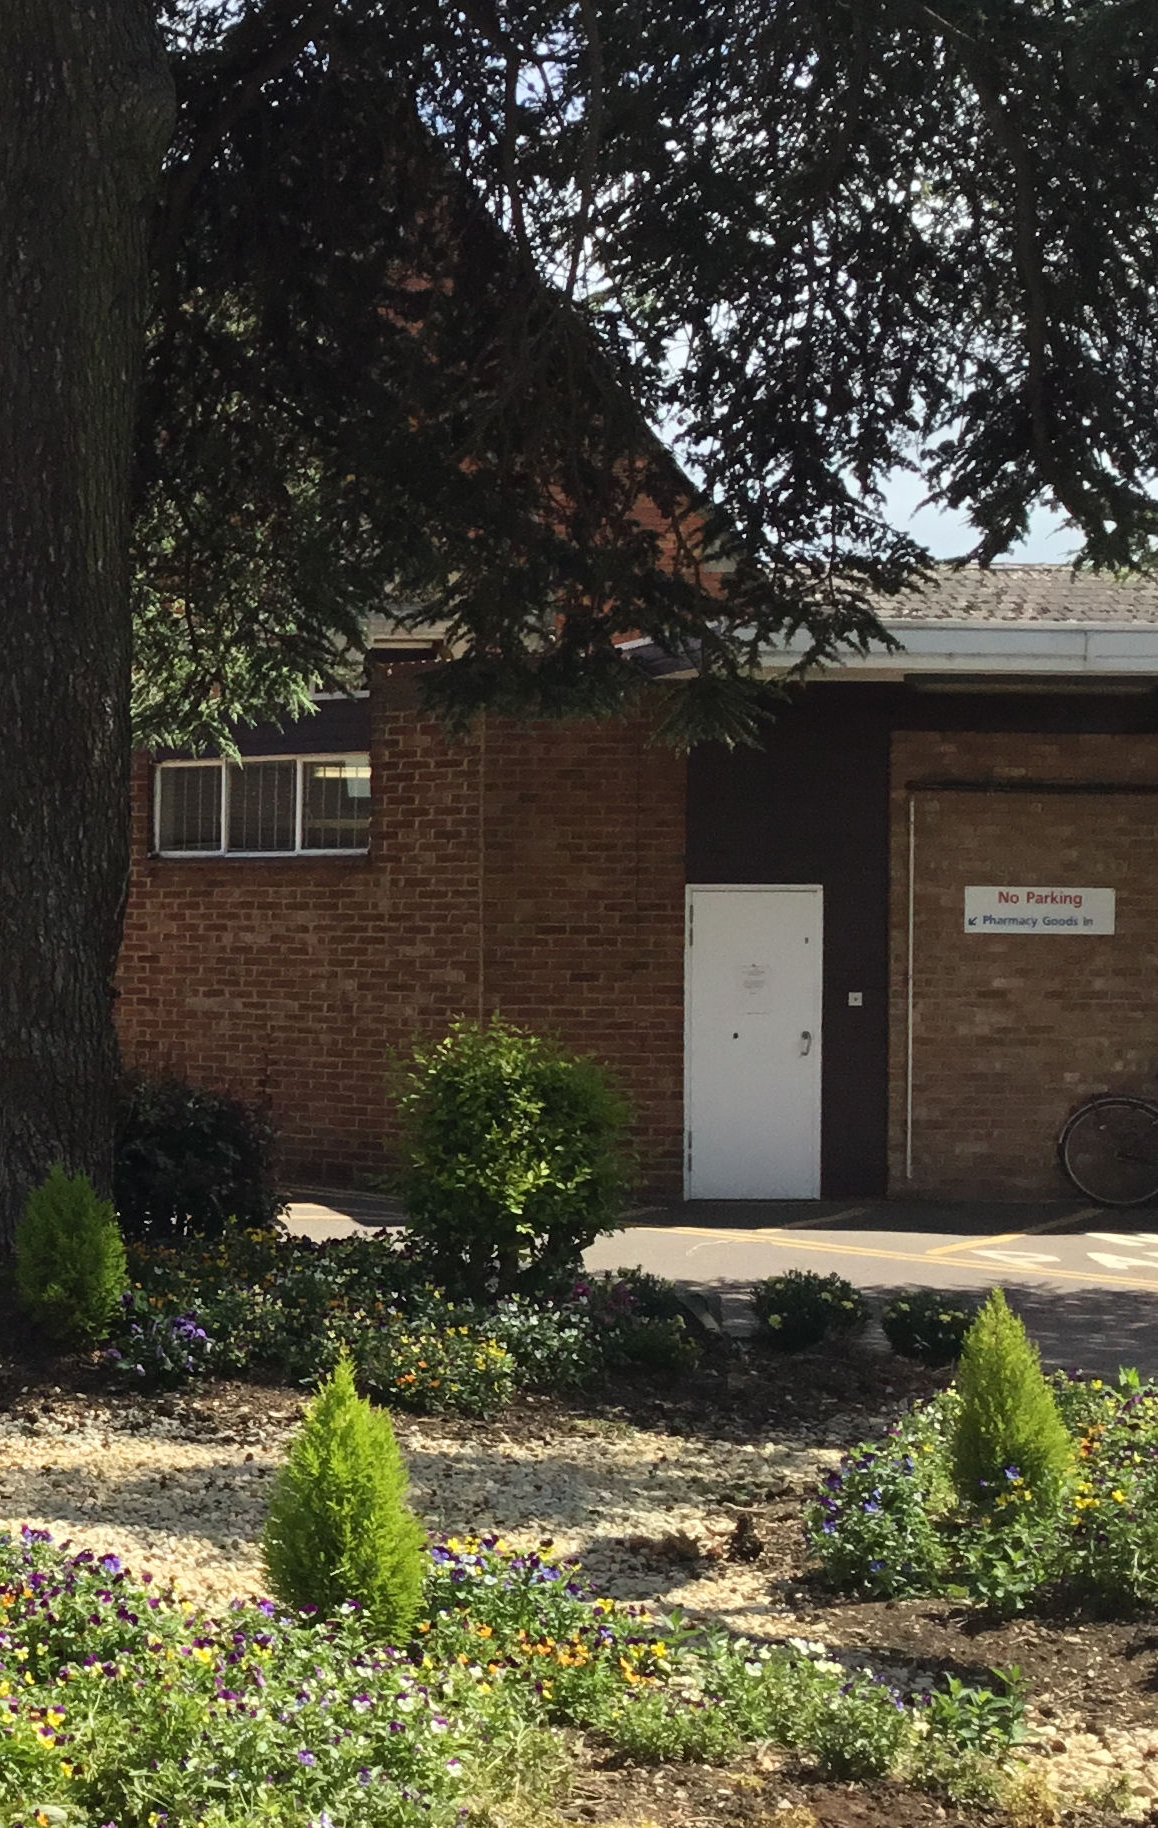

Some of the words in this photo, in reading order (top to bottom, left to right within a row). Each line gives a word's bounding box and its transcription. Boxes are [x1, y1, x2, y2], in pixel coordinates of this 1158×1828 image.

[998, 892, 1019, 904] No
[1027, 892, 1083, 908] Parking
[983, 915, 1038, 928] Pharmacy
[1042, 915, 1078, 927] Goods
